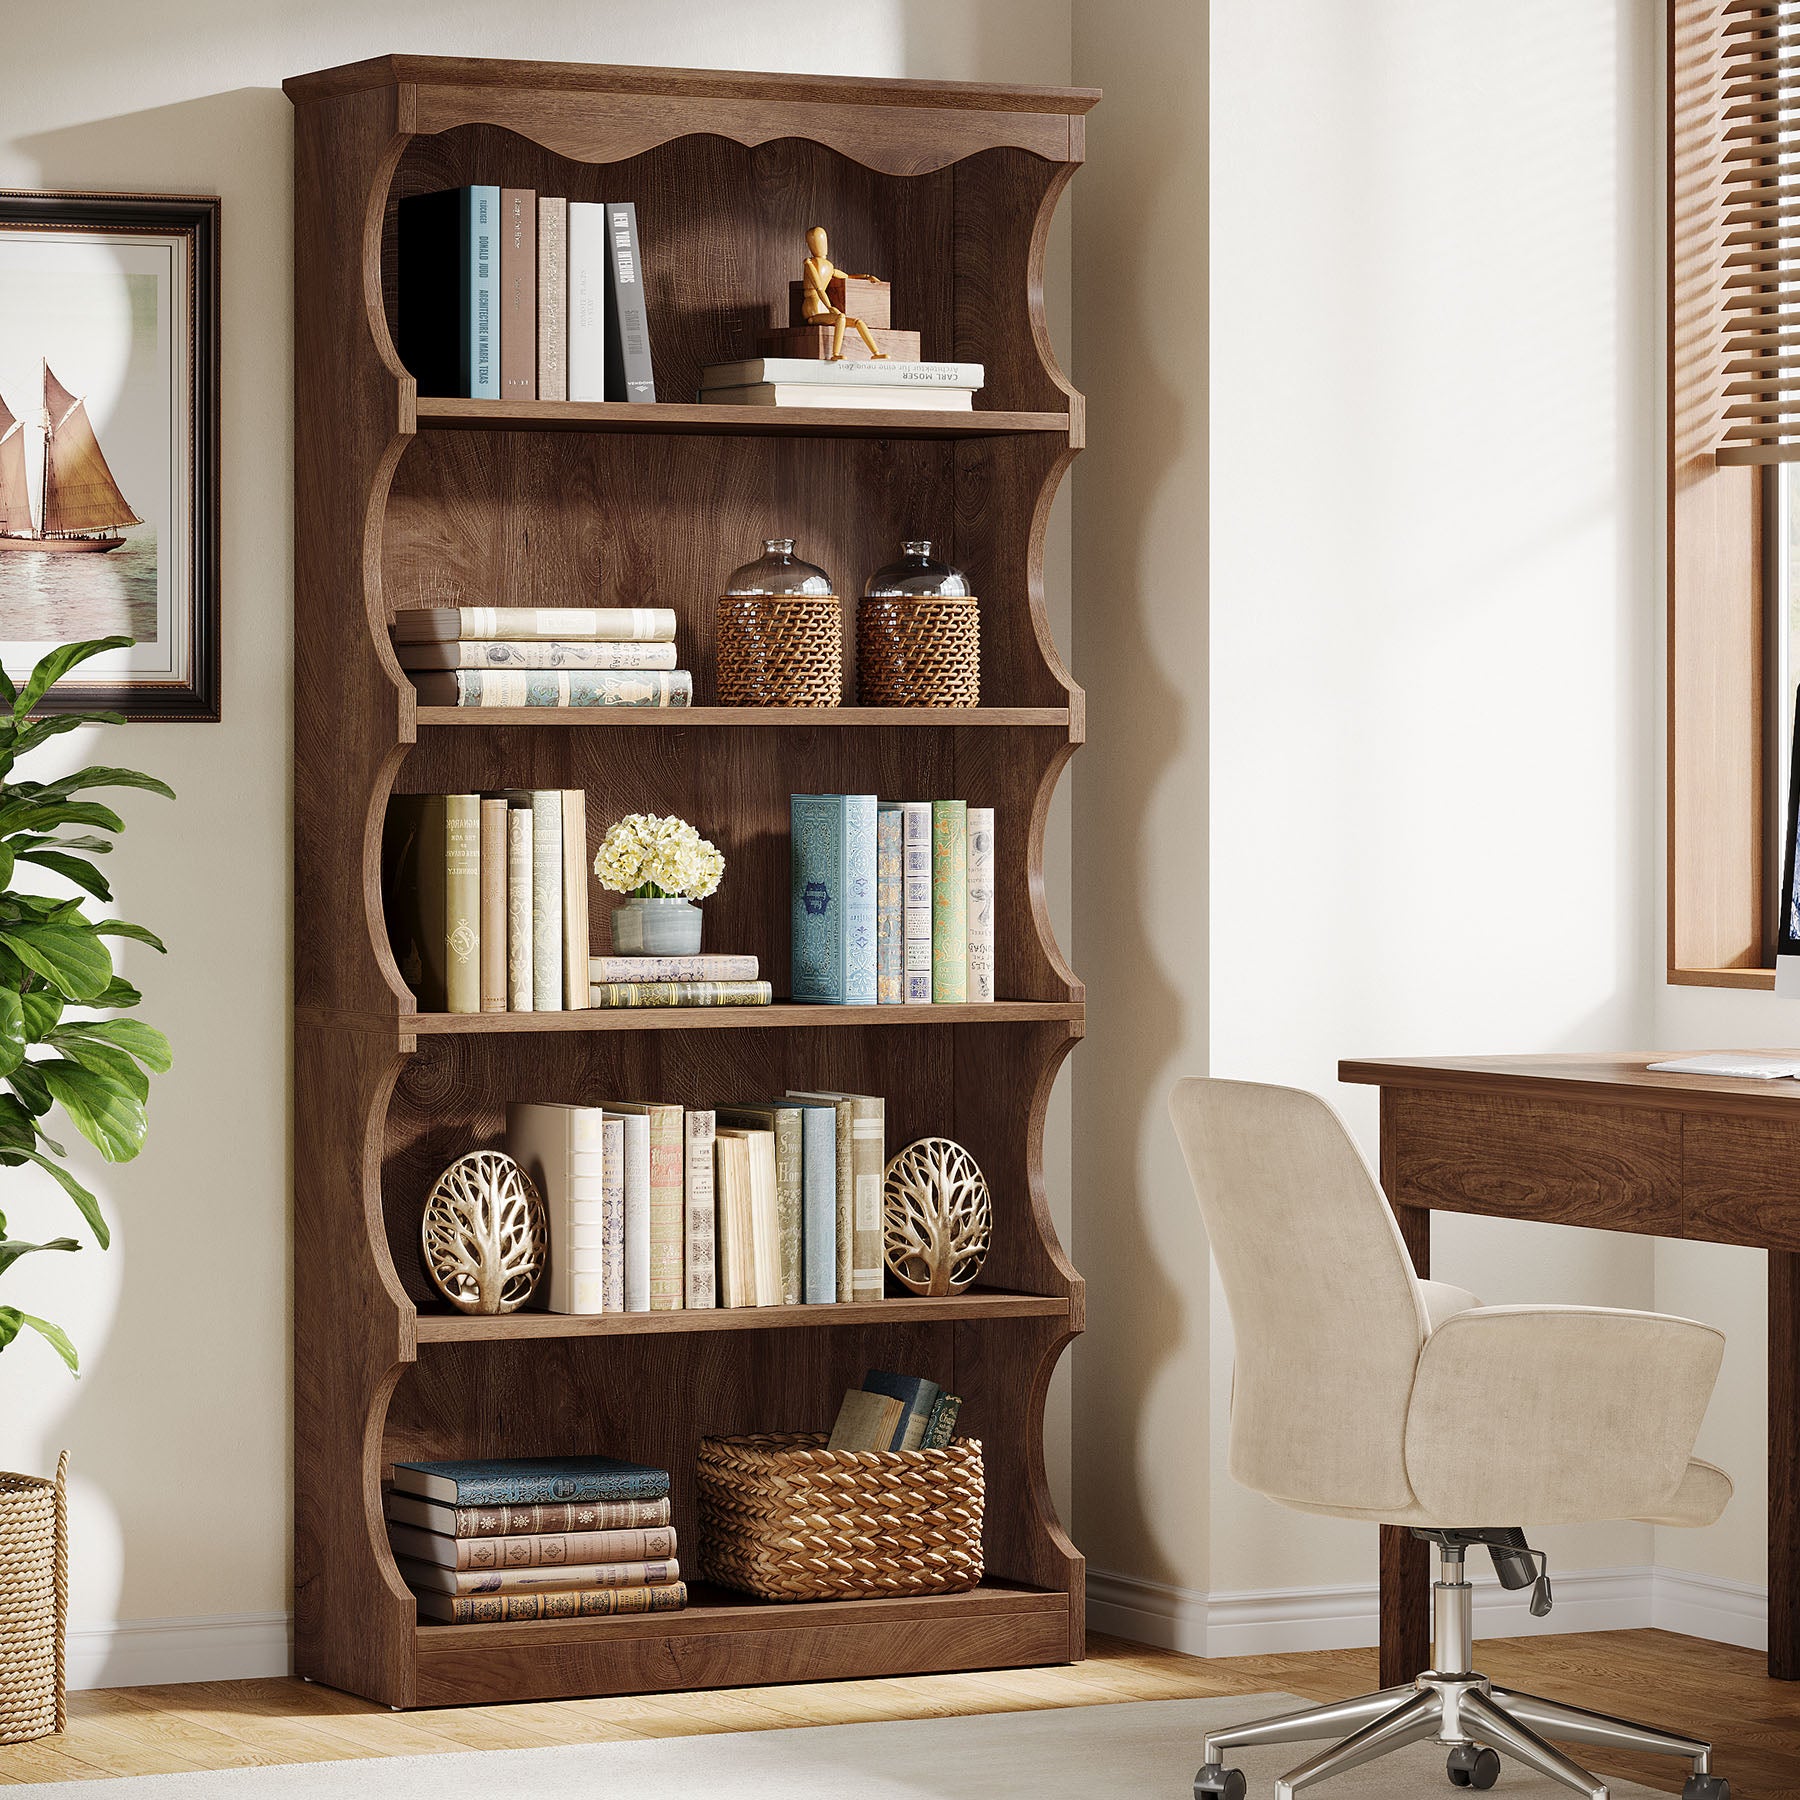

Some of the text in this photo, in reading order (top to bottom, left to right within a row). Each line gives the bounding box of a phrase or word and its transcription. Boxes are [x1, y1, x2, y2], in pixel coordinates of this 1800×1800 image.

[479, 235, 489, 278] DONALD JUDD
[613, 212, 635, 284] NEW YORK INTERIORS
[479, 289, 489, 334] ARCHITECTURE
[479, 366, 489, 385] TEXAS
[838, 363, 855, 371] Zeit
[902, 372, 959, 381] CARL MOSER
